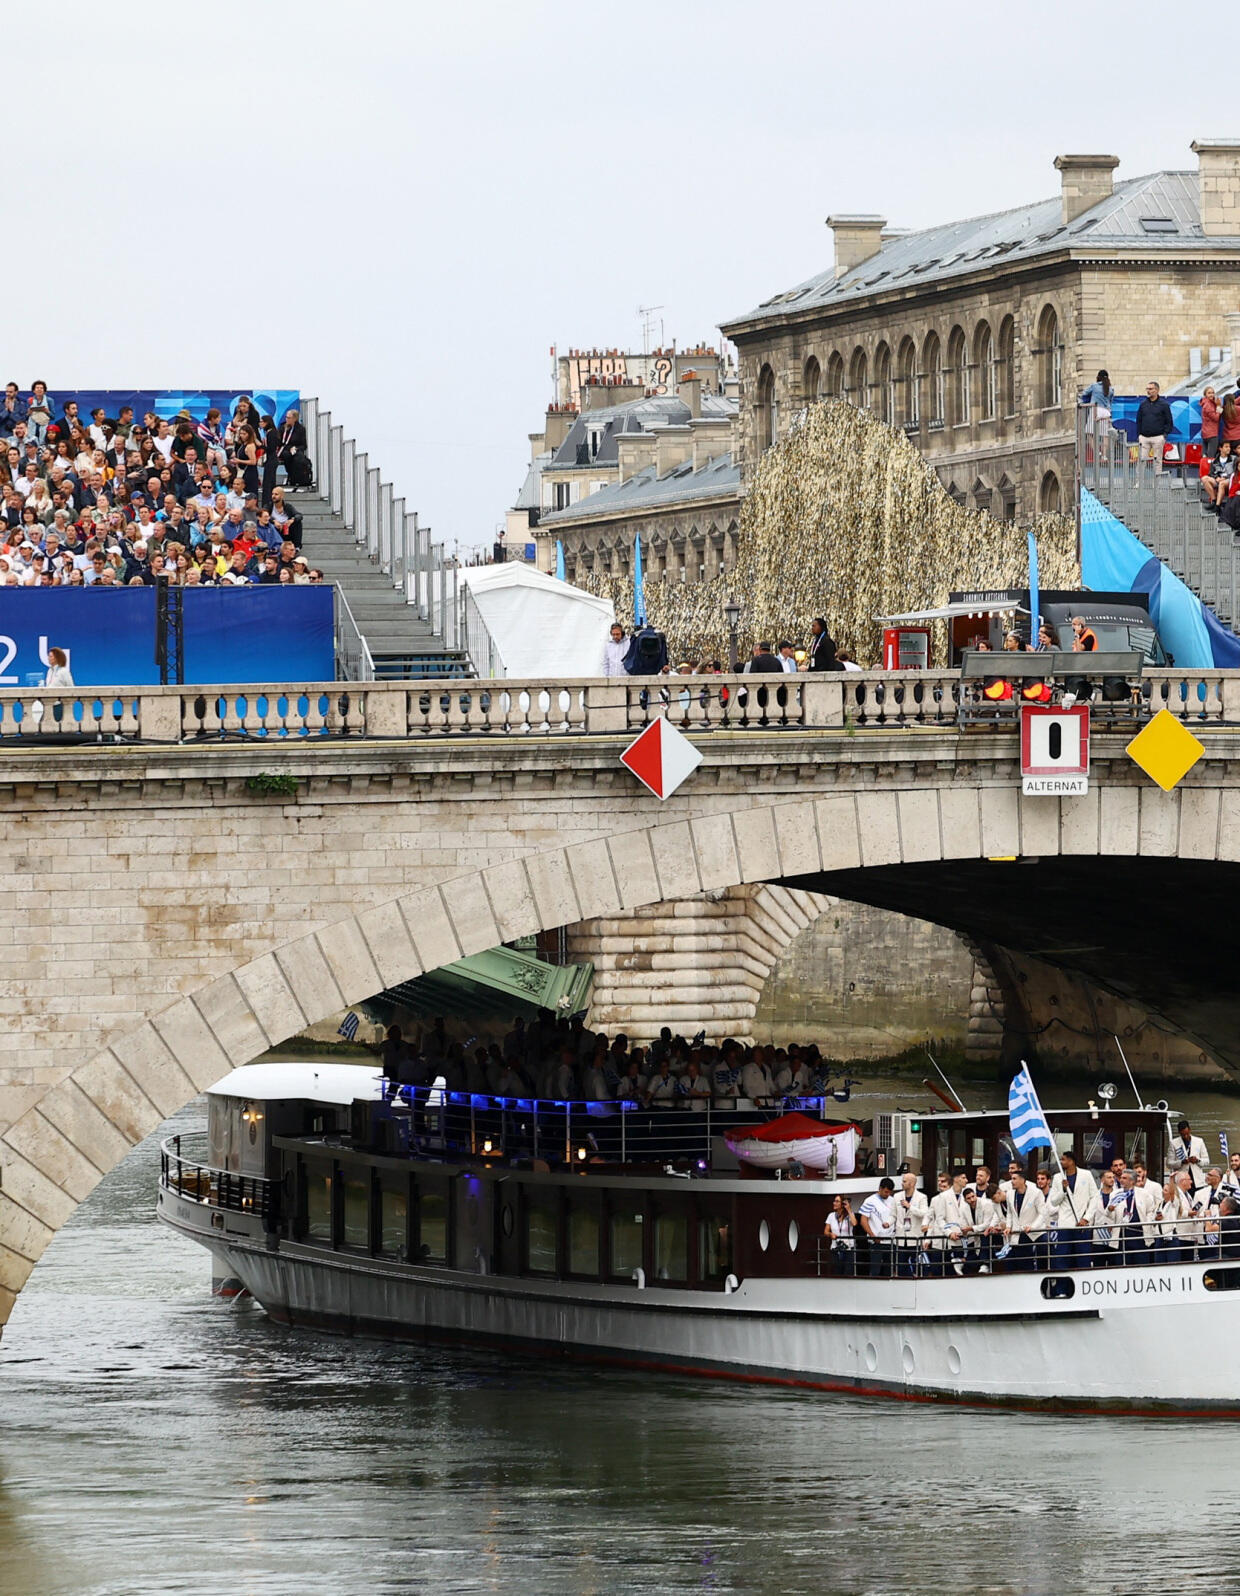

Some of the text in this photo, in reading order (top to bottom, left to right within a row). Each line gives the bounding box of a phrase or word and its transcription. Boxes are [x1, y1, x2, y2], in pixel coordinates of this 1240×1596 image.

[1026, 781, 1084, 791] ALTERNAT
[1081, 1276, 1192, 1295] DON JUAN II
